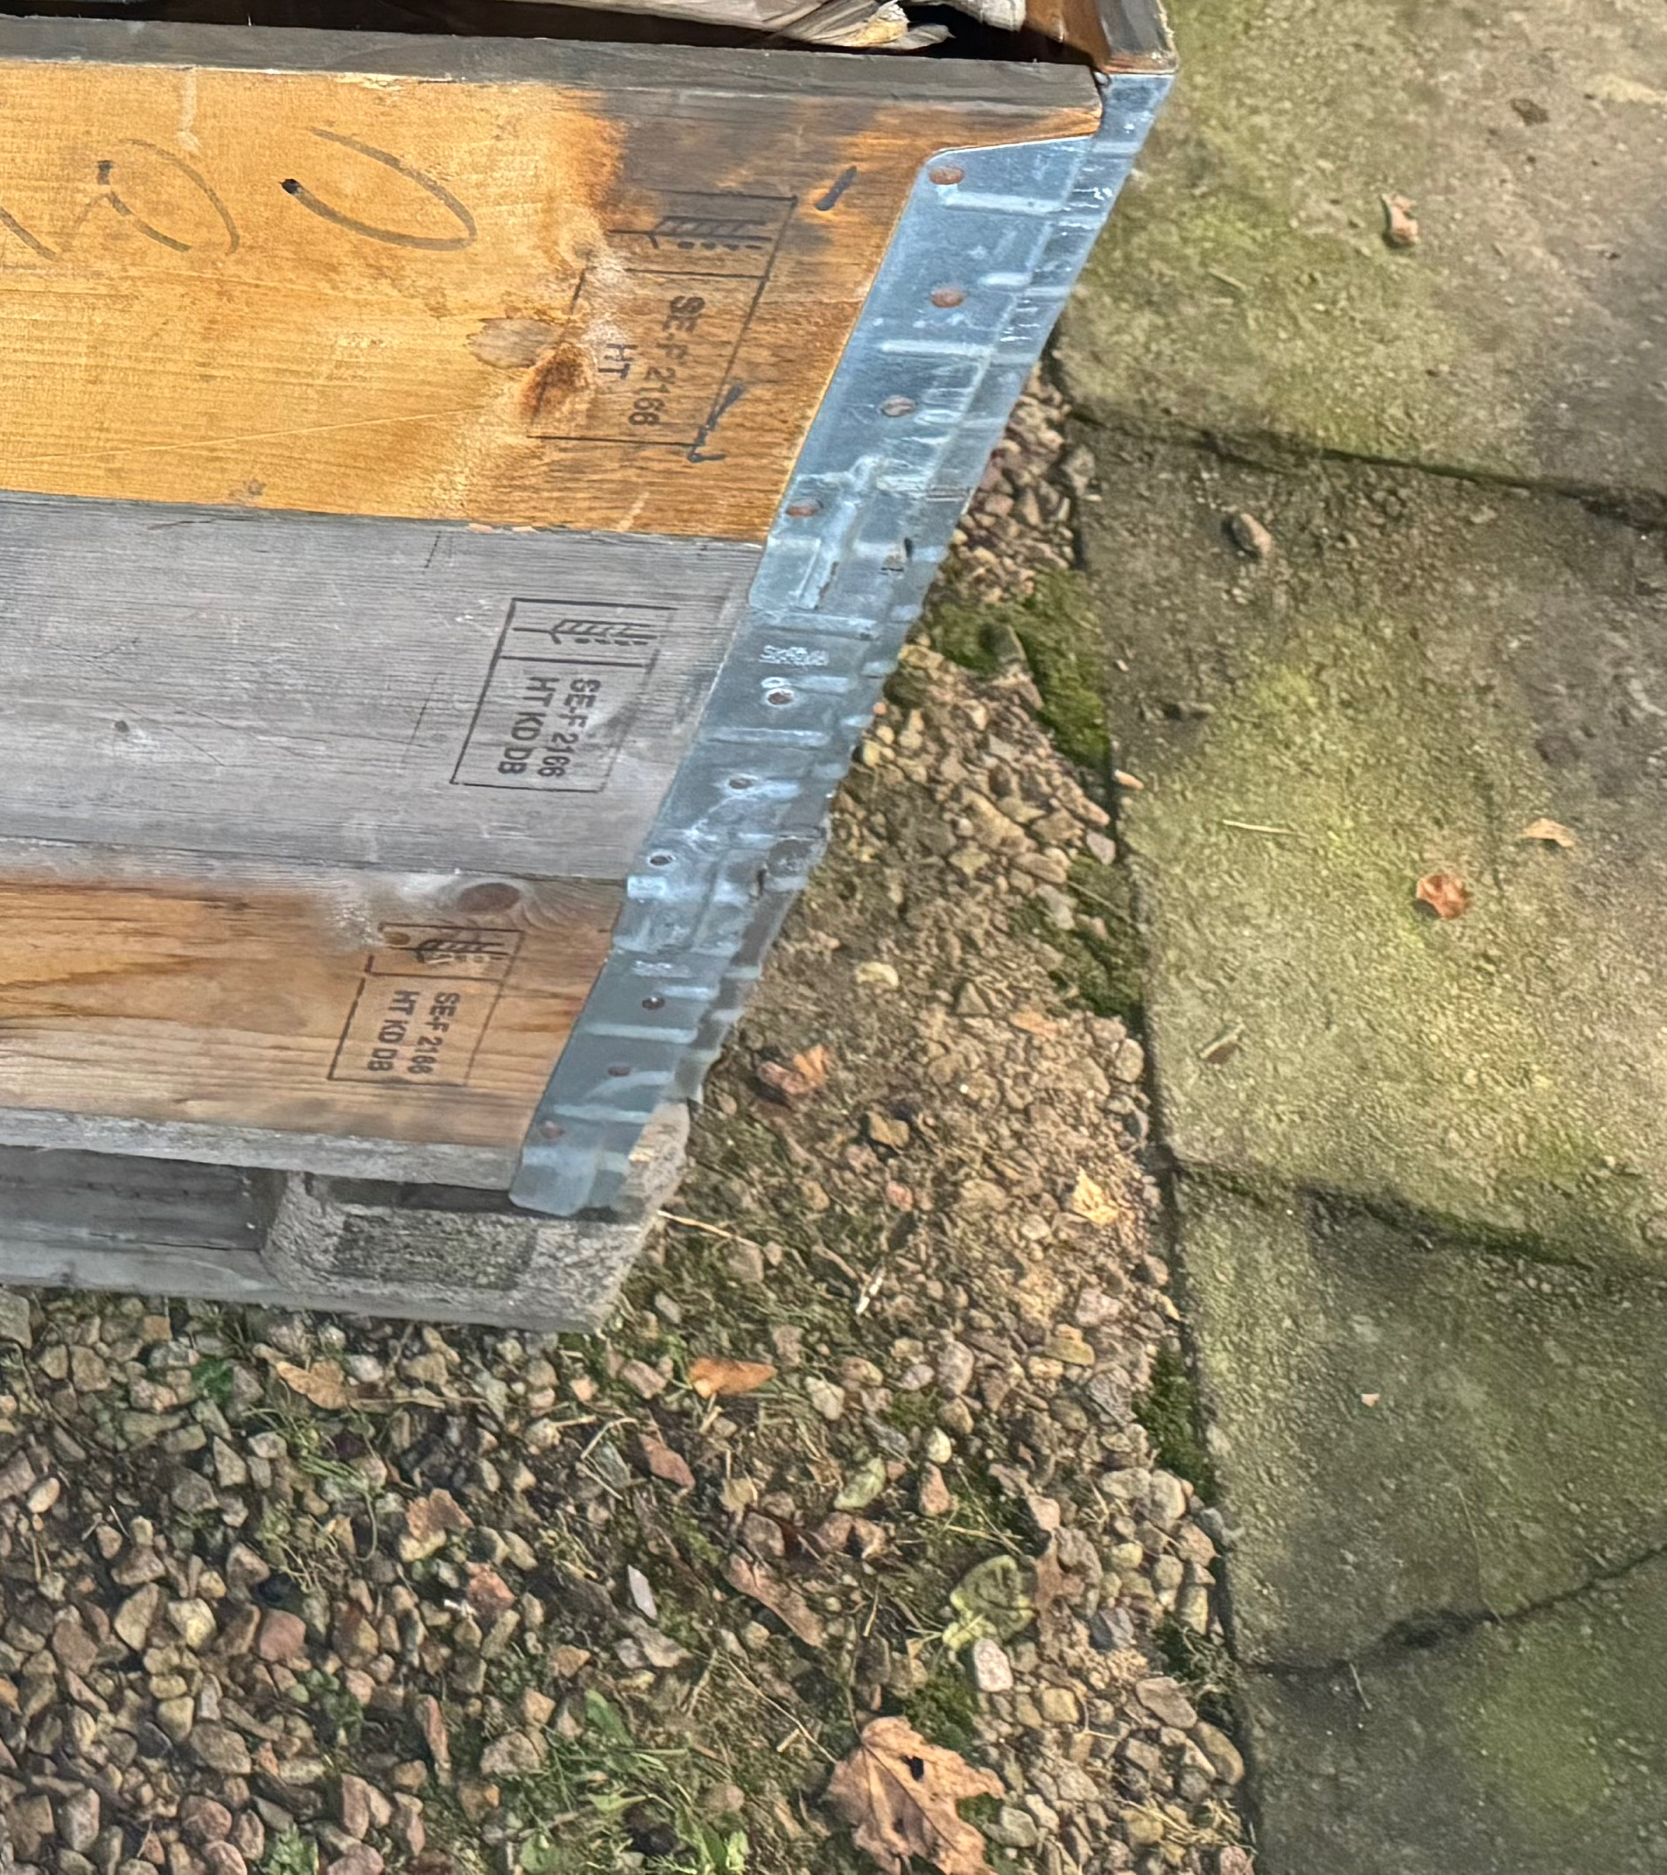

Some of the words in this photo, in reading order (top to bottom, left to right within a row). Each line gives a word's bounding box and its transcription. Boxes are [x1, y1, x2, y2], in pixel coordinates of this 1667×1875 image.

[597, 342, 638, 380] HT
[522, 676, 561, 708] HT
[510, 712, 547, 742] KD
[497, 746, 534, 776] DB
[388, 990, 421, 1016] HT
[377, 1019, 408, 1044] KD
[366, 1047, 399, 1073] DB
